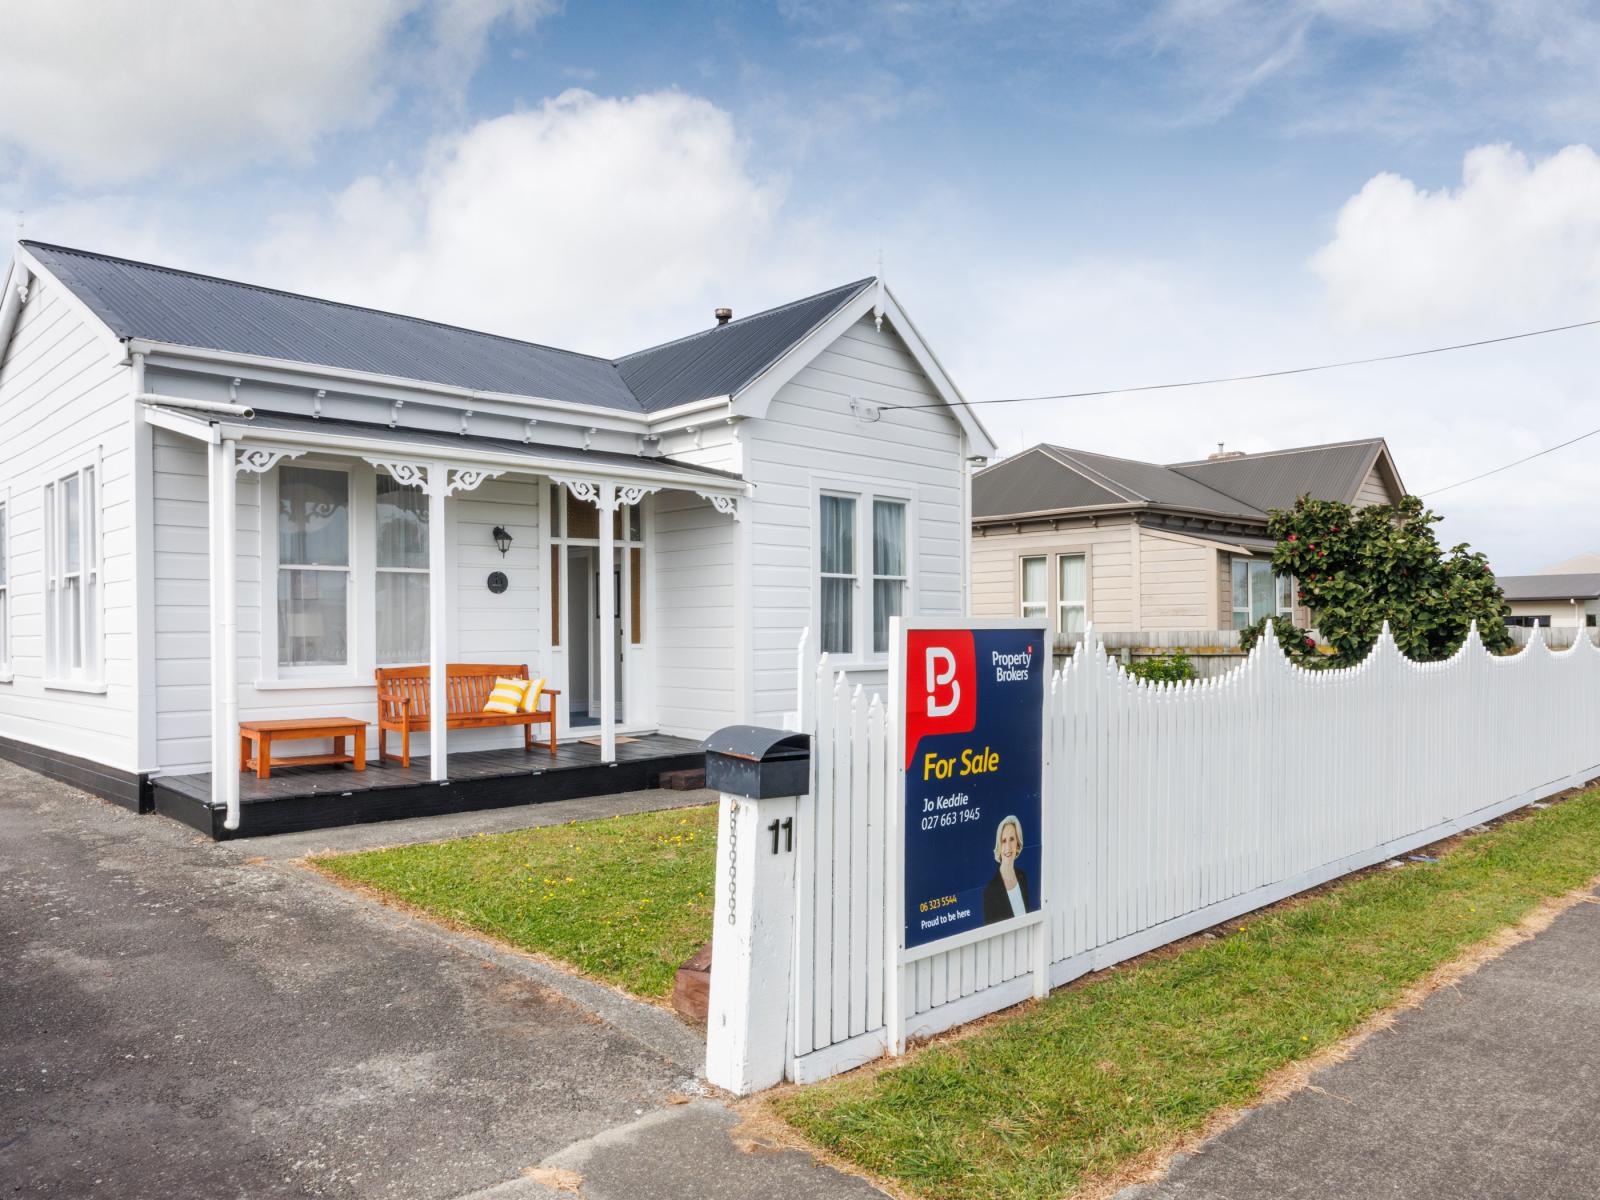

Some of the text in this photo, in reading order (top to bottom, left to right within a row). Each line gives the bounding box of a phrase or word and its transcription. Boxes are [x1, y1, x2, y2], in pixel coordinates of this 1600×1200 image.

[992, 650, 1032, 669] Property
[996, 666, 1029, 682] Brokers
[923, 746, 1000, 781] For Sale
[922, 793, 969, 813] Jo Keddie
[921, 807, 980, 831] 027 663 1945
[767, 816, 793, 855] 11
[919, 894, 957, 913] 06 323 5544
[921, 909, 971, 930] Proud to be here
